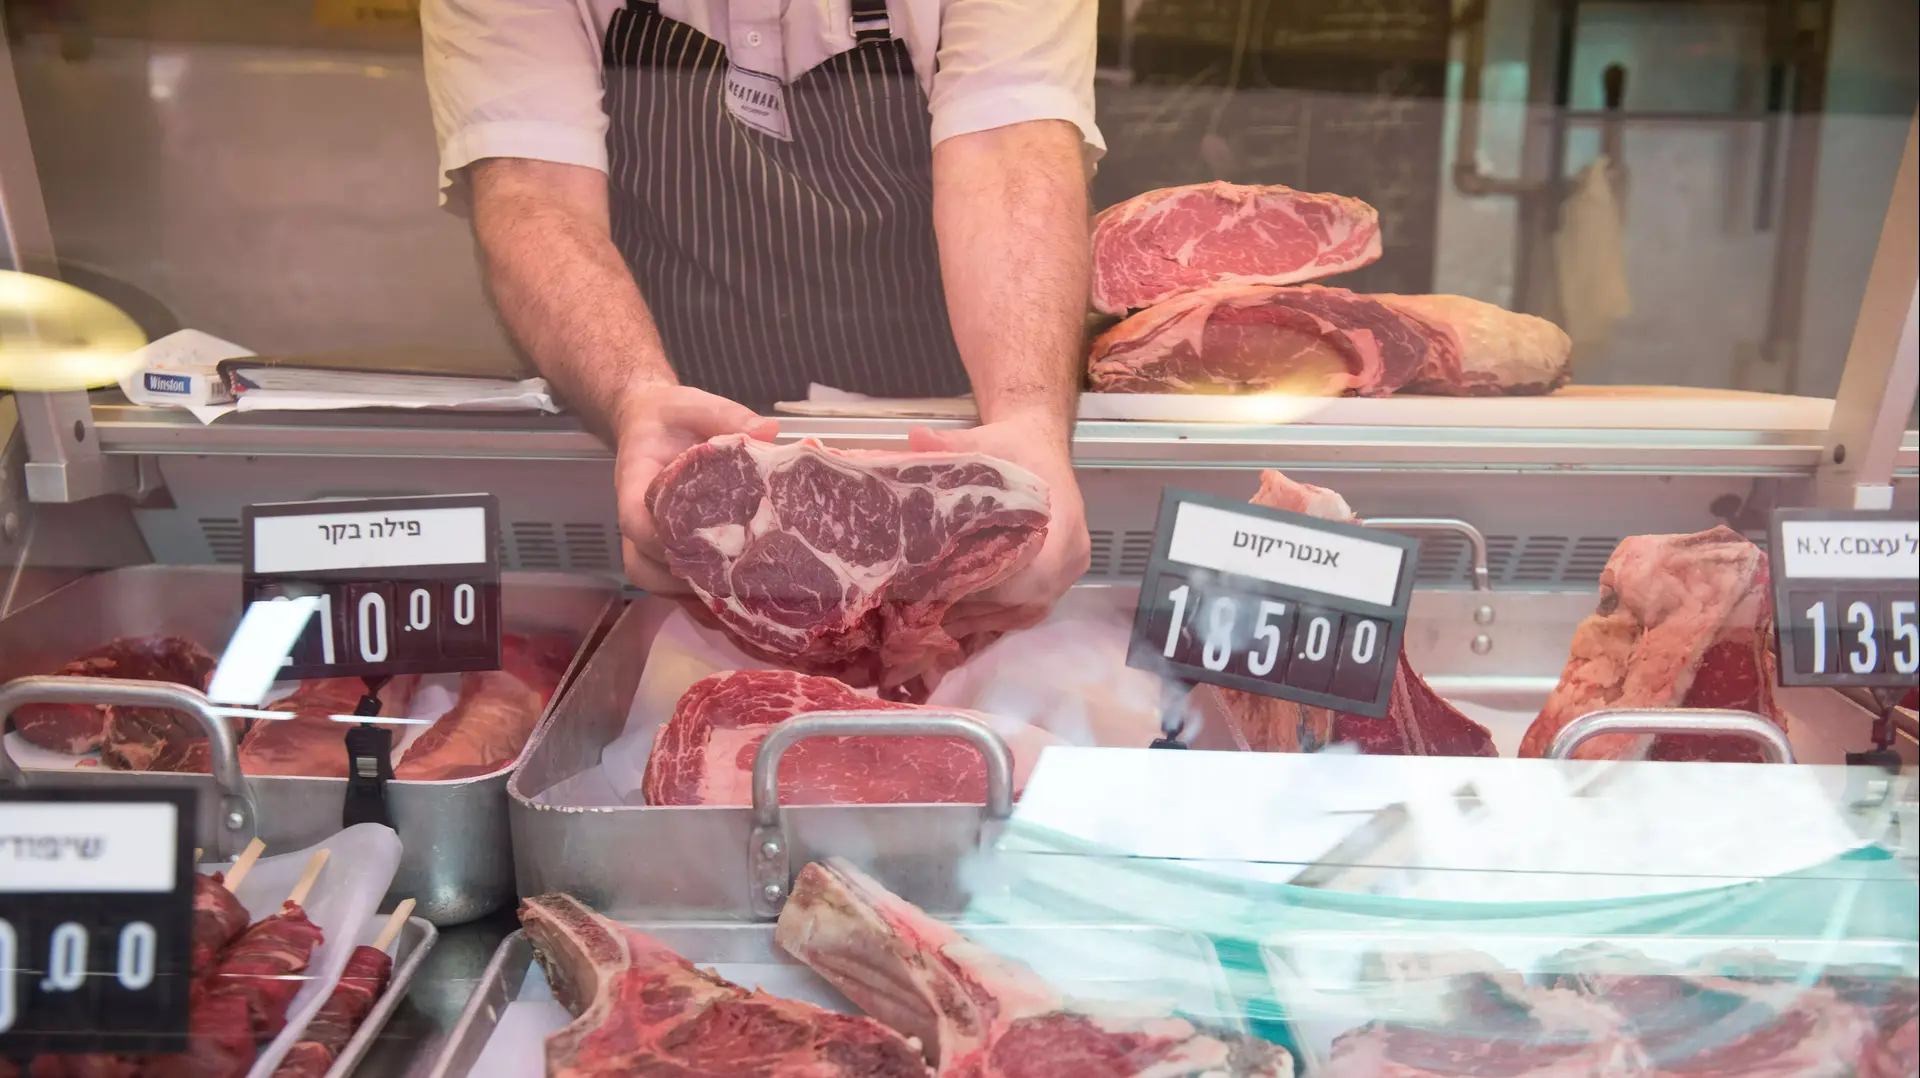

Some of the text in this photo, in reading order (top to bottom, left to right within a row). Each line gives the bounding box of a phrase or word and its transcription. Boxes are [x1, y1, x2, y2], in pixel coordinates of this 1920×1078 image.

[149, 375, 185, 392] Winston
[318, 517, 422, 545] פילה בקר
[1232, 529, 1340, 568] אנטריקוט
[268, 583, 475, 665] 10.00
[1806, 601, 1919, 674] 135
